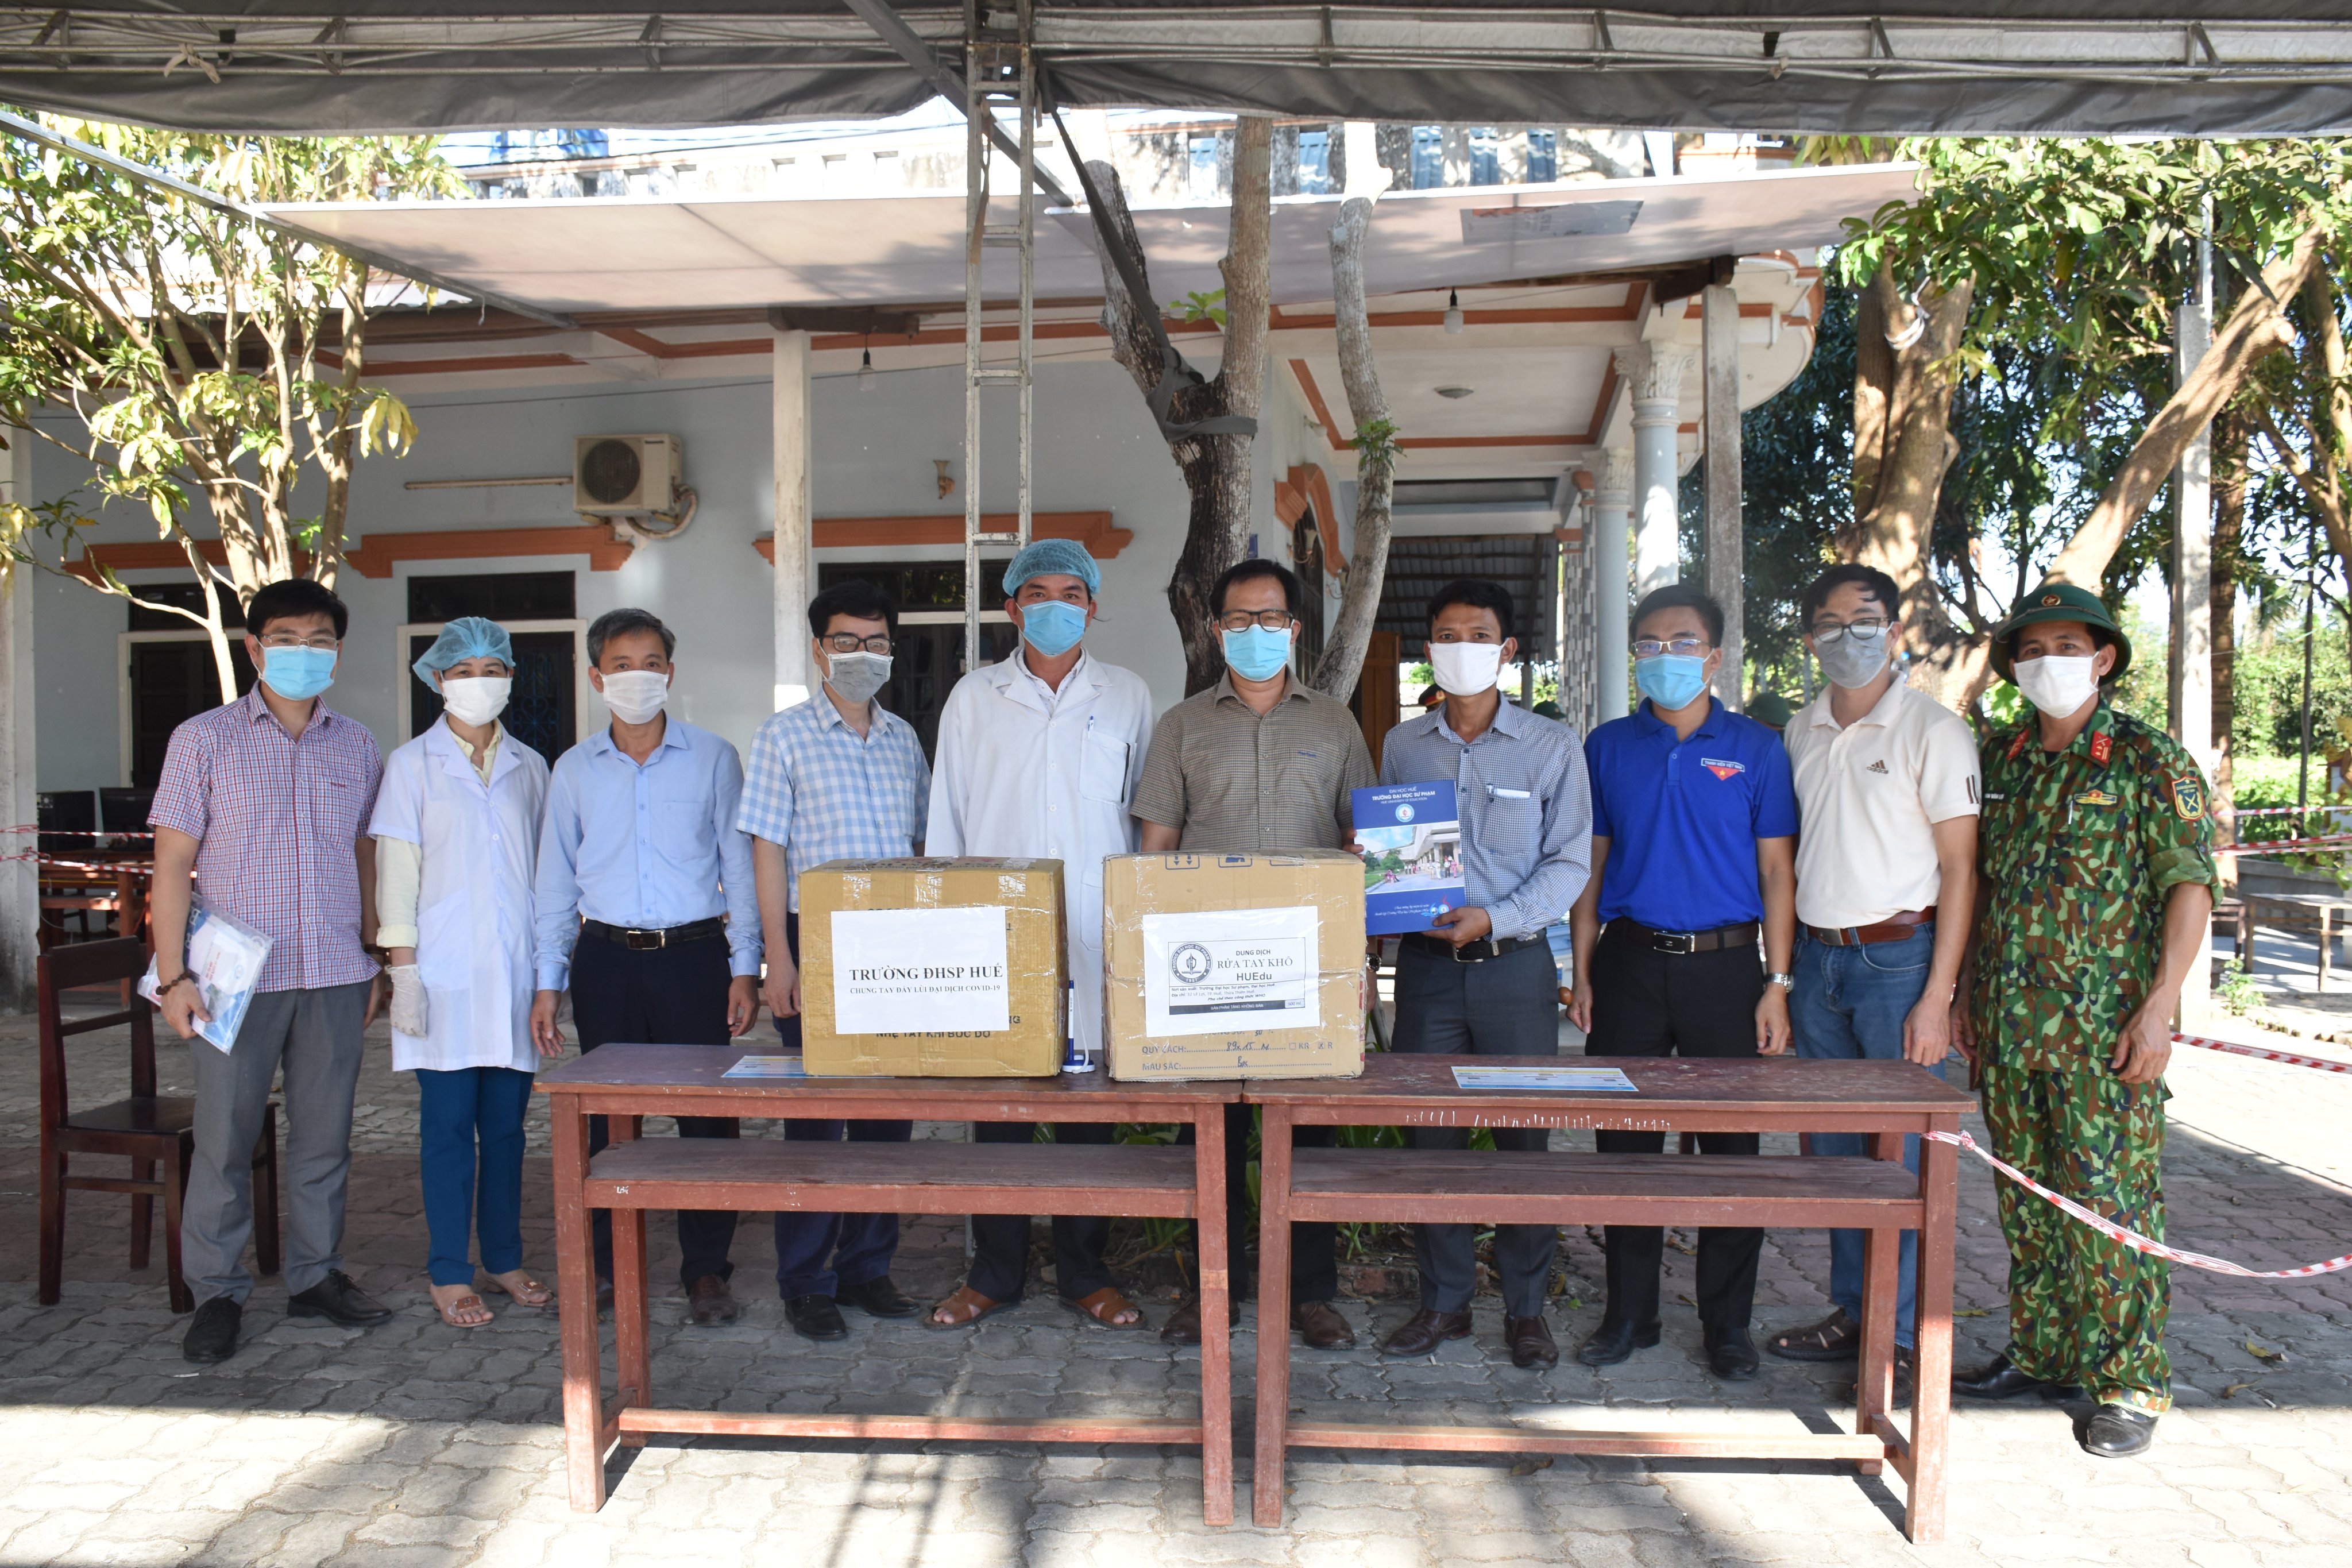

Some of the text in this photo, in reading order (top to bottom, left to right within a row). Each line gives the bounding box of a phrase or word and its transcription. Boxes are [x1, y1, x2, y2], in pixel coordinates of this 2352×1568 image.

[1867, 766, 1888, 774] adidas
[1217, 956, 1293, 969] RỬA TAY KHÔ
[849, 963, 1003, 980] TRƯỜNG ĐHSP HUẾ
[1237, 972, 1272, 981] HUEdu
[914, 984, 926, 992] LÙI
[1142, 1046, 1159, 1055] QUY
